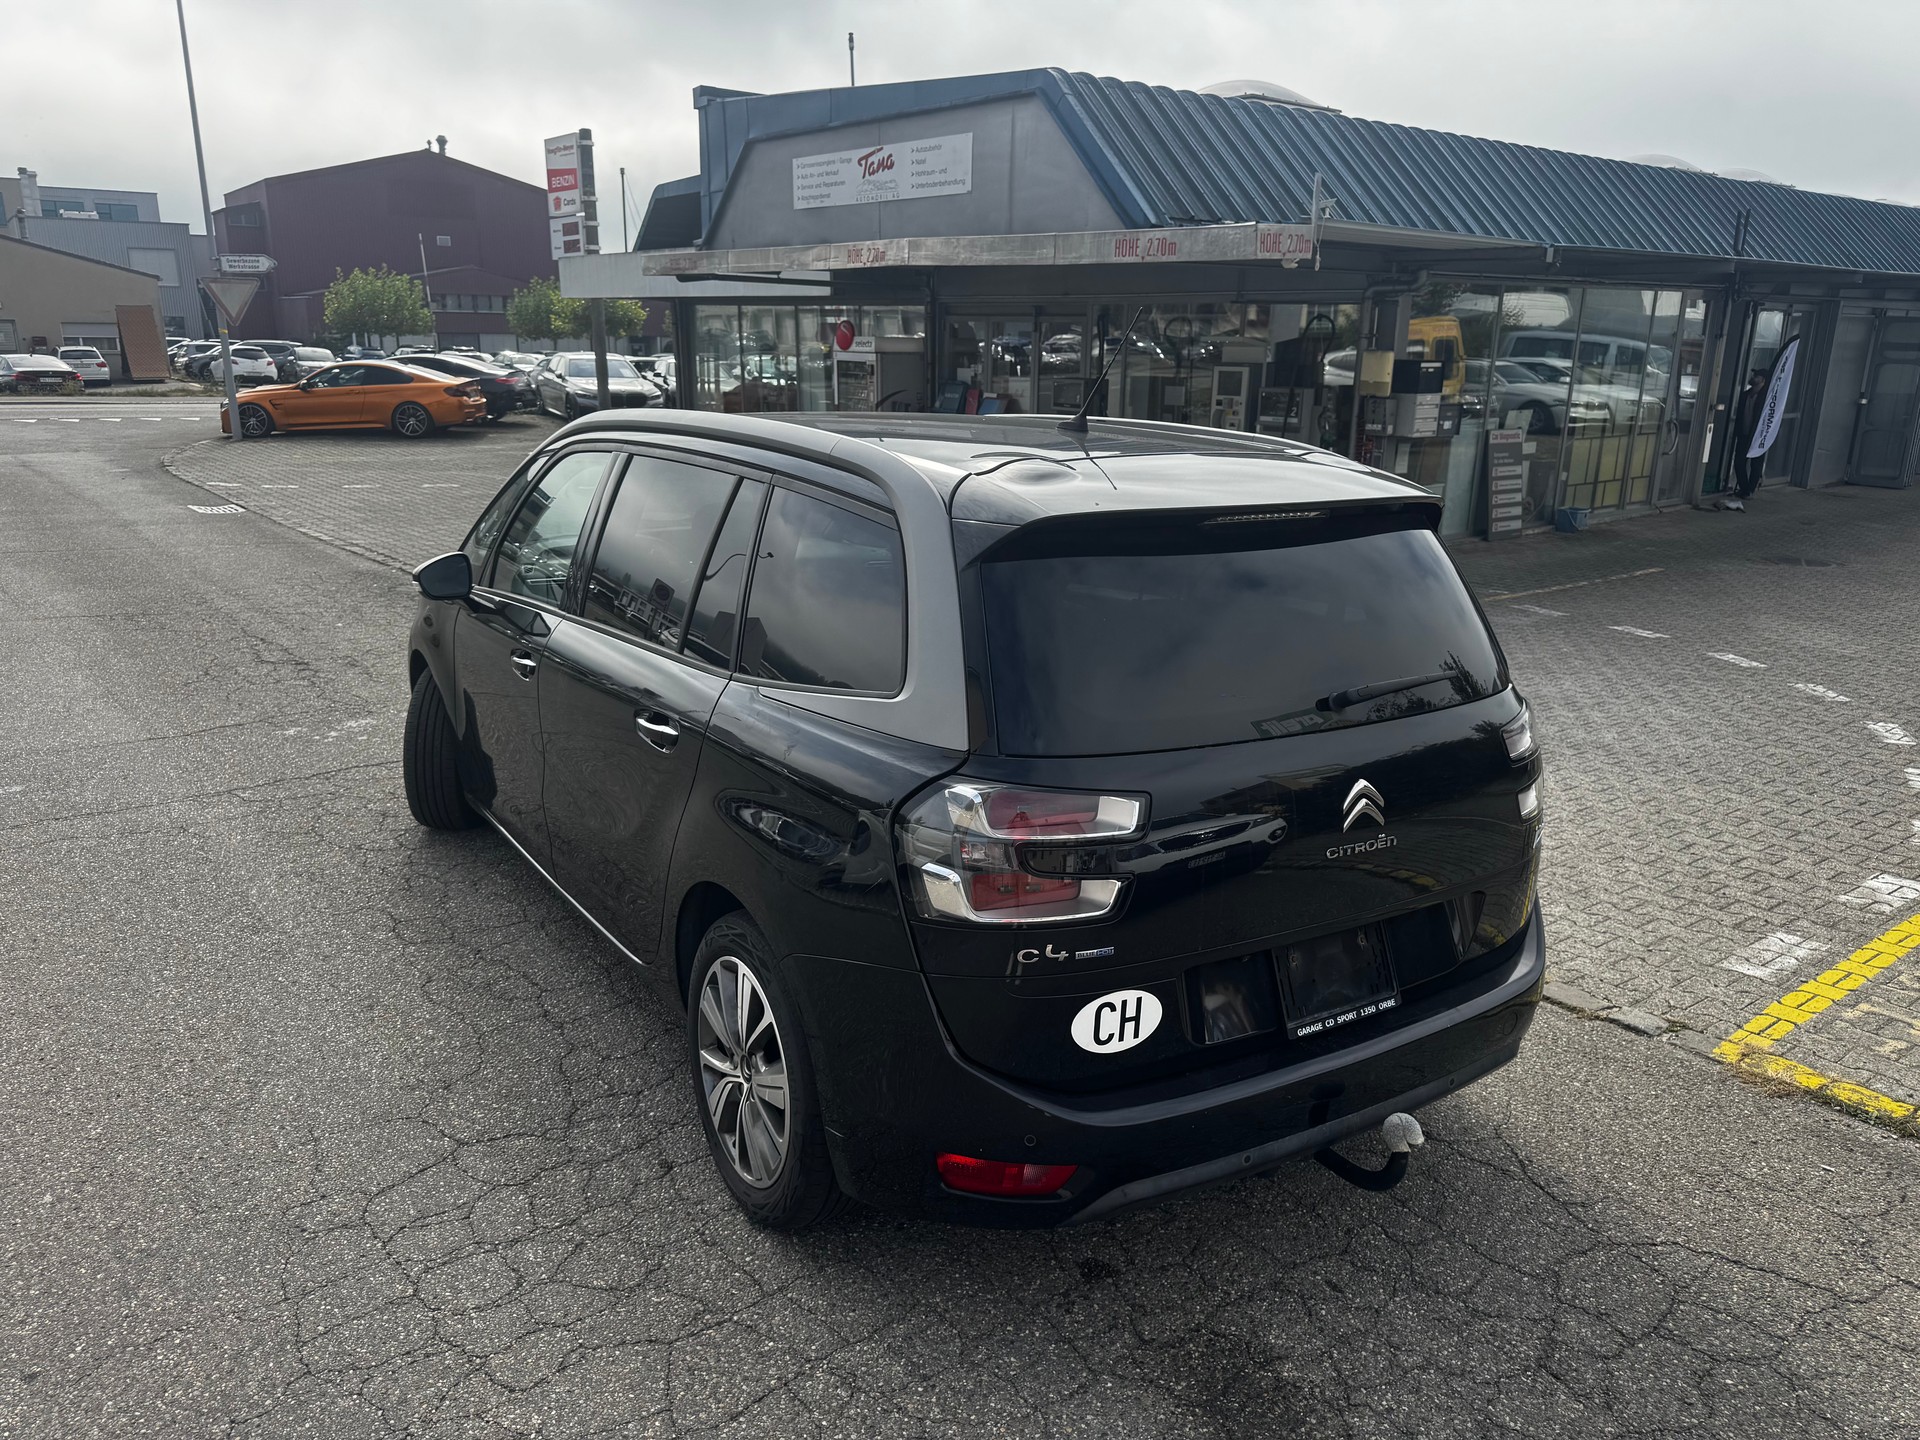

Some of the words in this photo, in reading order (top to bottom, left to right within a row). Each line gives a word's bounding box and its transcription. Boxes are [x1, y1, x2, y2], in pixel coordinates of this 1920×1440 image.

[858, 146, 895, 179] Tana
[552, 174, 575, 188] BENZIN
[1114, 235, 1140, 258] HÖHE
[1146, 237, 1177, 257] 2.70m
[1260, 229, 1282, 254] HÖHE
[1290, 406, 1297, 417] 2
[1093, 996, 1143, 1046] CH
[1297, 1022, 1323, 1037] GARAGE
[1325, 1018, 1335, 1028] CD
[1336, 1010, 1358, 1024] SPORT
[1360, 1004, 1376, 1017] 1350
[1378, 998, 1396, 1010] ORBE
